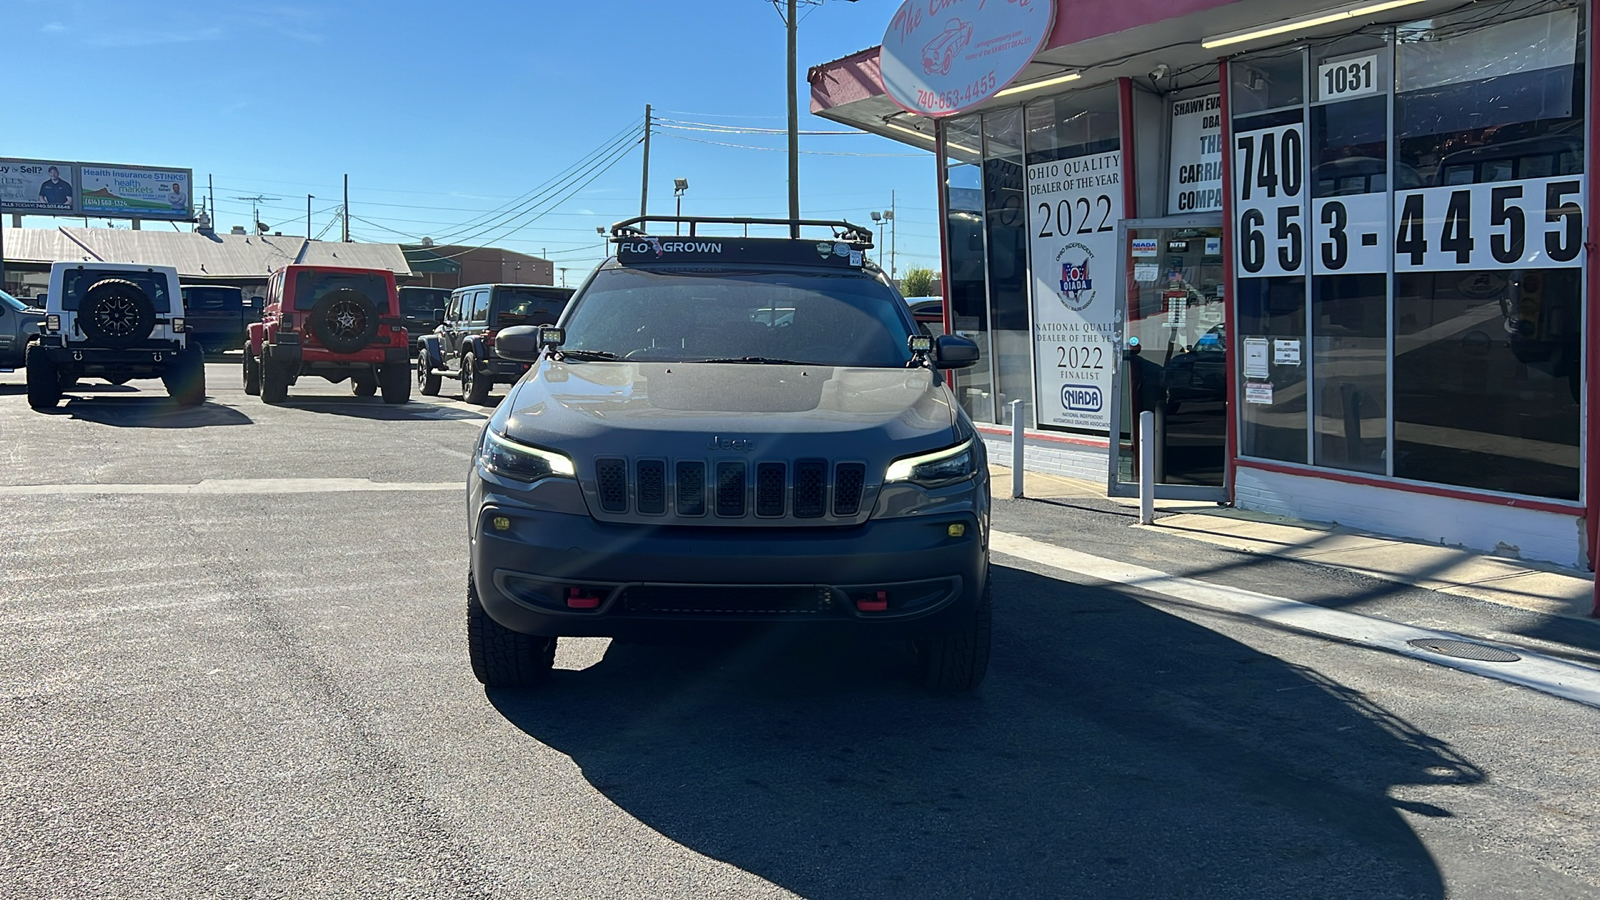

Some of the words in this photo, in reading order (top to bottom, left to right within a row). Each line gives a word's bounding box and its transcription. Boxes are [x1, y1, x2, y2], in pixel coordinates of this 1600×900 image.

[895, 0, 922, 44] The
[1325, 61, 1372, 94] 1031
[916, 70, 996, 109] 740-653-4455
[1174, 98, 1204, 116] SHAWN
[1202, 115, 1220, 129] DBA
[1200, 134, 1222, 155] THE
[20, 165, 43, 174] Sell?
[1029, 164, 1059, 180] OHIO
[1064, 154, 1120, 177] QUALITY
[1238, 128, 1302, 201] 740
[83, 169, 111, 177] Health
[112, 171, 153, 180] Insurance
[154, 173, 186, 181] STINKS!
[114, 178, 141, 187] health
[1030, 181, 1062, 195] DEALER
[1063, 179, 1074, 191] OF
[1076, 176, 1094, 189] THE
[1095, 172, 1119, 187] YEAR
[118, 186, 154, 194] markets
[85, 198, 101, 206] (614)
[1038, 194, 1113, 238] 2022
[663, 242, 722, 253] GROWN
[1063, 280, 1087, 291] OIADA
[1036, 323, 1079, 332] NATIONAL
[1037, 334, 1066, 342] DEALER
[1069, 334, 1079, 342] OF
[1057, 346, 1103, 369] 2022
[1060, 370, 1100, 380] FINALIST
[1064, 390, 1099, 407] NIADA
[707, 435, 756, 453] Jeep
